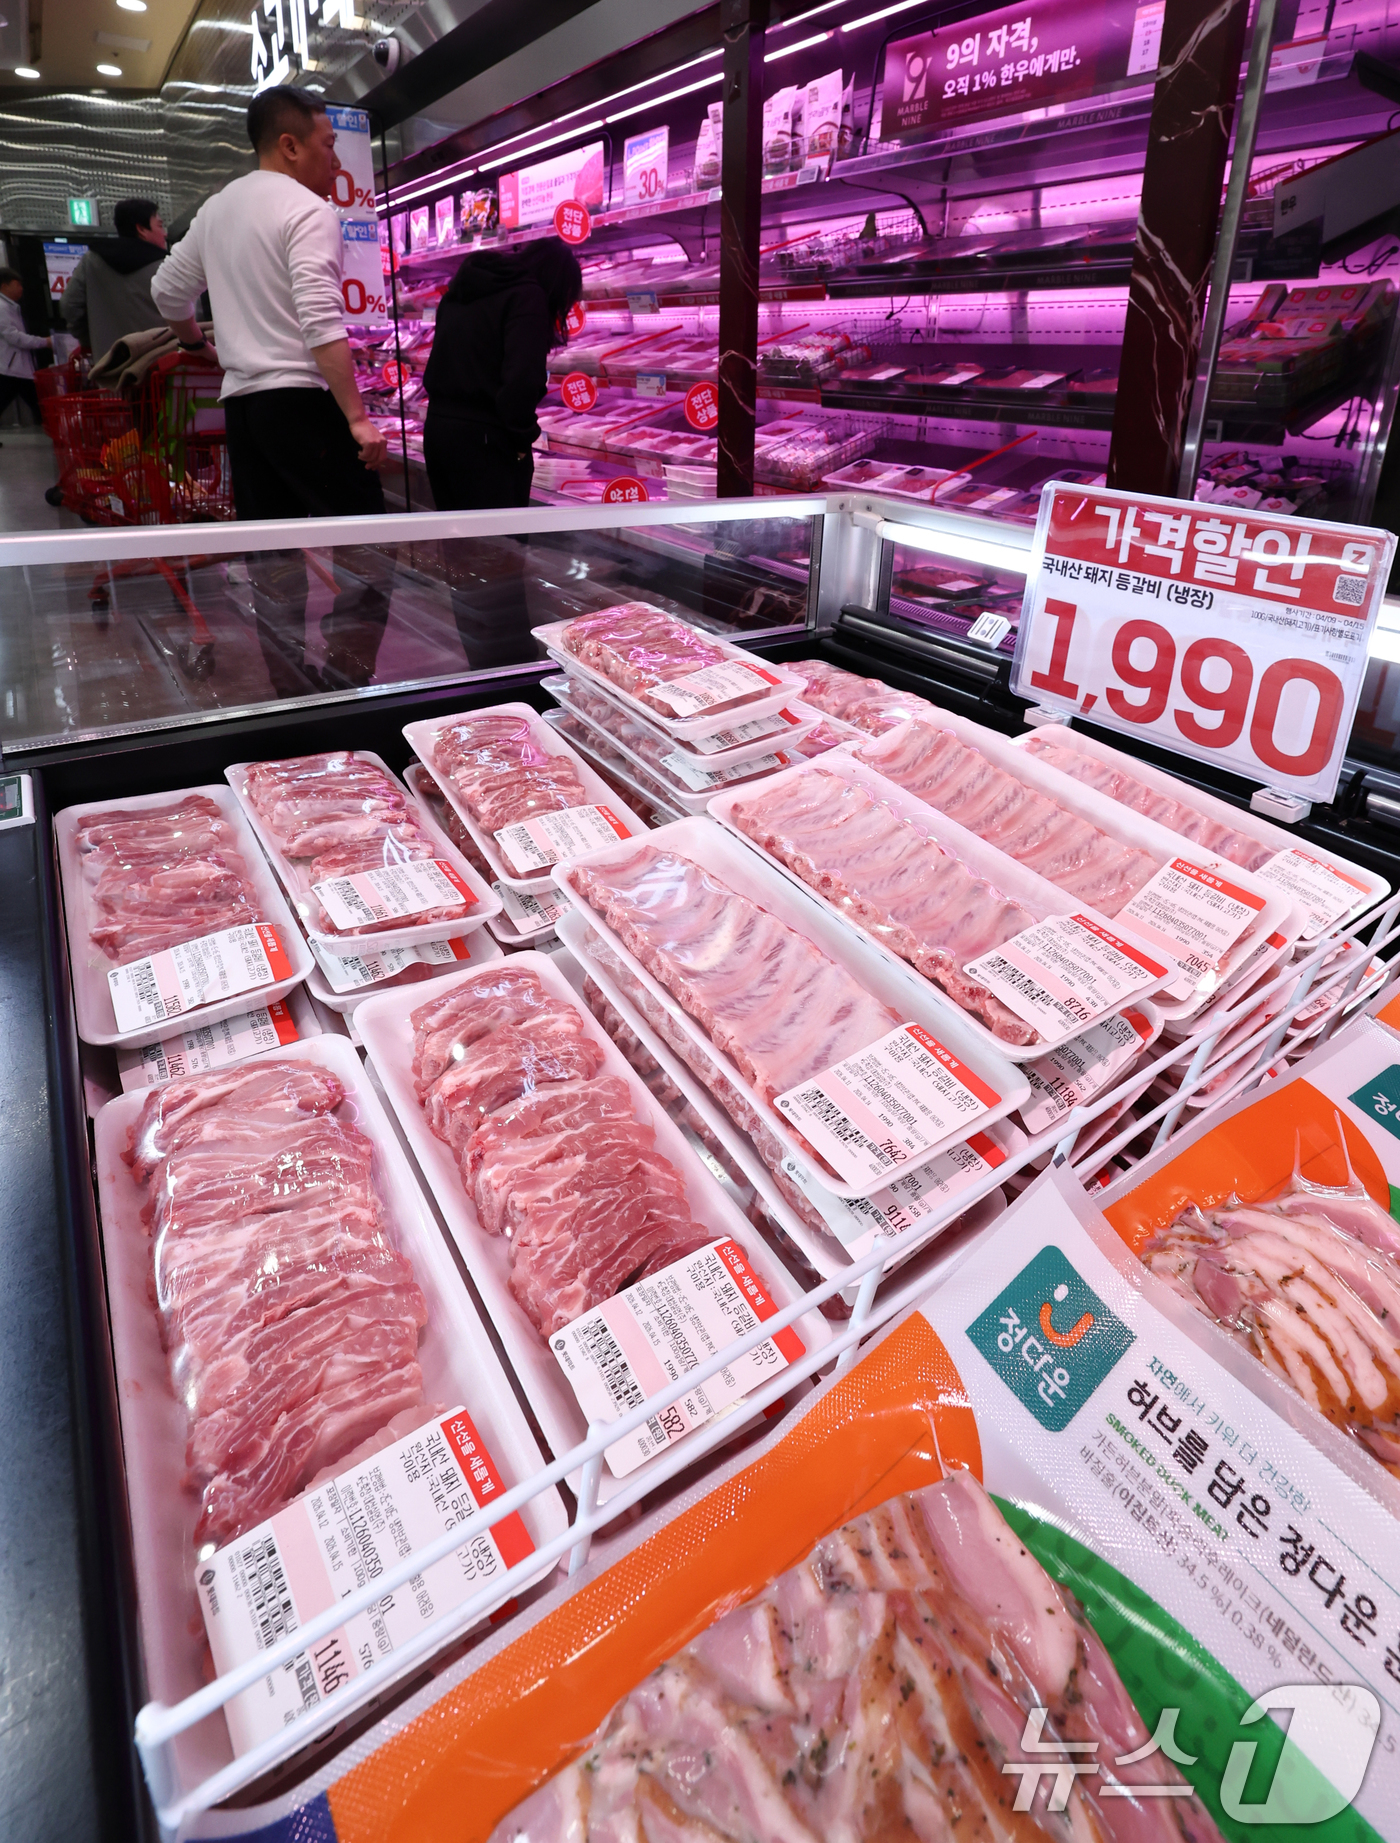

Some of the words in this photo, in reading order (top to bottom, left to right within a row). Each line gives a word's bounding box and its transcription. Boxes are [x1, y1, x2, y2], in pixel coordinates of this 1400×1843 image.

[946, 32, 981, 69] 9의
[986, 18, 1039, 59] 자격,
[943, 75, 969, 99] 오직
[973, 70, 997, 92] 1%
[1000, 45, 1081, 86] 한우에게만.
[336, 113, 359, 129] 할인
[897, 100, 929, 116] MARBLE
[901, 114, 922, 127] NINE
[1057, 111, 1095, 129] MARBLE
[1097, 106, 1123, 123] NINE
[332, 169, 375, 209] 0%
[639, 167, 665, 200] 30%
[561, 220, 583, 238] 상품
[563, 207, 584, 224] 전단
[348, 224, 368, 239] 할인
[50, 275, 72, 293] 4
[1037, 274, 1071, 285] MARBLE
[1073, 272, 1098, 283] NINE
[342, 278, 386, 314] 0%
[567, 379, 587, 395] 전단
[571, 390, 592, 408] 상품
[691, 389, 713, 409] 전단
[696, 406, 719, 424] 상품
[1028, 411, 1061, 423] MARBLE
[1063, 413, 1087, 424] NINE
[1095, 505, 1313, 598] 가격할인
[1043, 557, 1082, 581] 국내산
[1084, 564, 1113, 588] 돼지
[1115, 571, 1162, 600] 등갈비
[1167, 582, 1214, 611] (냉장)
[1285, 606, 1311, 619] 행사기간
[1316, 611, 1337, 625] 04/09
[1344, 618, 1366, 631] 04/15
[1030, 597, 1346, 778] 1,990
[1174, 860, 1199, 874] 신선을
[1197, 872, 1221, 888] 새롭게
[1166, 871, 1187, 883] 국내산
[1187, 882, 1202, 891] 돼지
[1202, 889, 1226, 904] 등갈비
[1227, 902, 1250, 916] (냉장)
[369, 904, 389, 919] 11661
[543, 904, 558, 917] 11263
[1311, 912, 1329, 925] 7841
[1076, 917, 1100, 931] 신선을
[1099, 931, 1124, 947] 새롭게
[1175, 935, 1190, 944] 1990
[1202, 949, 1213, 958] 354
[365, 960, 383, 978] 11462
[1124, 962, 1148, 978] (냉장)
[1184, 953, 1209, 972] 7045
[1059, 974, 1075, 987] 1990
[1084, 996, 1099, 1007] 438
[163, 994, 181, 1016] 11582
[1062, 997, 1091, 1020] 8716
[261, 1028, 274, 1043] (냉장)
[1112, 1020, 1143, 1042] (냉장)
[185, 1040, 195, 1051] 1990
[190, 1057, 198, 1068] 576
[883, 1045, 904, 1062] 구이용
[912, 1027, 936, 1047] 신선을
[931, 1045, 960, 1068] 새롭게
[166, 1053, 185, 1078] 11462
[888, 1040, 932, 1078] 원산지:국내산
[931, 1080, 967, 1112] (돼지고기)
[897, 1035, 920, 1053] 국내산
[916, 1052, 935, 1068] 돼지
[931, 1067, 957, 1089] 등갈비
[954, 1089, 979, 1111] (냉장)
[1049, 1057, 1065, 1070] 1990
[1074, 1079, 1087, 1091] 562
[1049, 1075, 1079, 1108] 11184
[877, 1113, 893, 1127] 1990
[903, 1138, 915, 1149] 384
[878, 1138, 907, 1164] 7642
[956, 1147, 985, 1172] (냉장)
[882, 1204, 911, 1232] 9114
[907, 1204, 921, 1217] 458
[685, 1267, 705, 1291] 구이용
[692, 1259, 732, 1315] 원산지:국내산
[721, 1245, 745, 1274] 신선을
[739, 1272, 766, 1306] 새롭게
[703, 1253, 726, 1281] 국내산
[720, 1282, 739, 1302] 돼지
[732, 1302, 756, 1331] 등갈비
[653, 1315, 669, 1336] 소비기한
[996, 1307, 1071, 1408] 정다운
[663, 1359, 679, 1381] 1990
[684, 1398, 698, 1416] 582
[1148, 1356, 1204, 1415] 자연에서
[1208, 1415, 1239, 1447] 키워
[1238, 1442, 1257, 1465] 더
[1258, 1460, 1310, 1512] 건강한
[398, 1451, 420, 1483] 구이용
[450, 1419, 476, 1456] 신선을
[466, 1452, 496, 1496] 새롭게
[410, 1441, 449, 1513] 원산지:국내산
[1105, 1413, 1155, 1466] SMOKED
[1156, 1465, 1192, 1506] DUCK
[1192, 1503, 1227, 1541] MEAT
[424, 1431, 450, 1468] 국내산
[439, 1466, 461, 1494] 돼지
[450, 1492, 474, 1522] 등갈
[469, 1534, 497, 1578] (냉장)
[1127, 1379, 1208, 1474] 허브를
[1207, 1459, 1270, 1538] 담은
[1279, 1524, 1380, 1638] 정다운
[326, 1486, 342, 1514] 포장일자
[340, 1526, 357, 1557] 소비기한
[310, 1496, 329, 1529] 2026.04.12
[323, 1535, 343, 1571] 2026.04.15
[359, 1642, 373, 1670] 576
[1176, 1555, 1208, 1589] 34.5
[1231, 1610, 1264, 1649] 0.38
[313, 1638, 349, 1695] 1146
